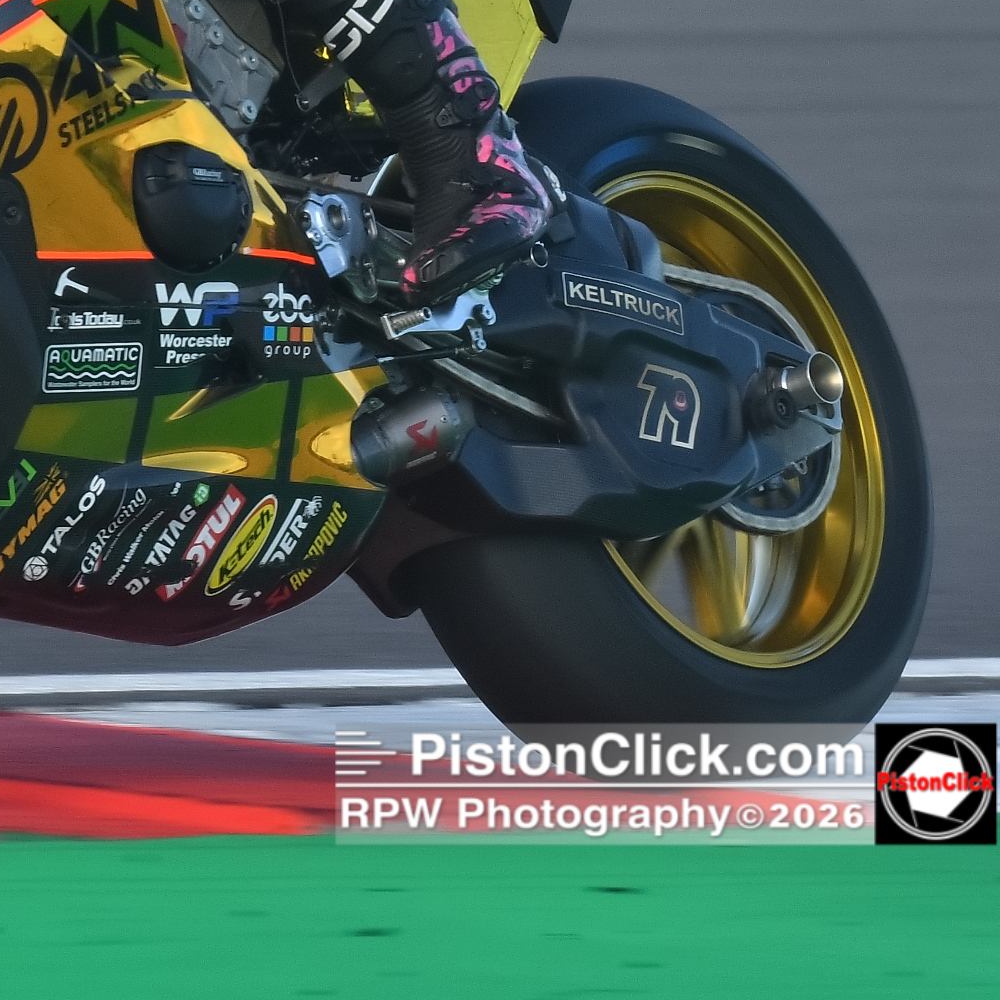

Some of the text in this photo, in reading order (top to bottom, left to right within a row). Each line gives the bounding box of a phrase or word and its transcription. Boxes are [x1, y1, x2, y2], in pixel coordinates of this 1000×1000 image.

[568, 280, 680, 327] KELTRUCK
[48, 346, 140, 364] AQUAMATIC
[159, 333, 233, 349] Worcester
[263, 344, 312, 359] group
[41, 474, 106, 555] TALOS
[80, 488, 147, 574] GBRacing
[106, 563, 127, 586] Chris
[122, 530, 144, 564] Walker
